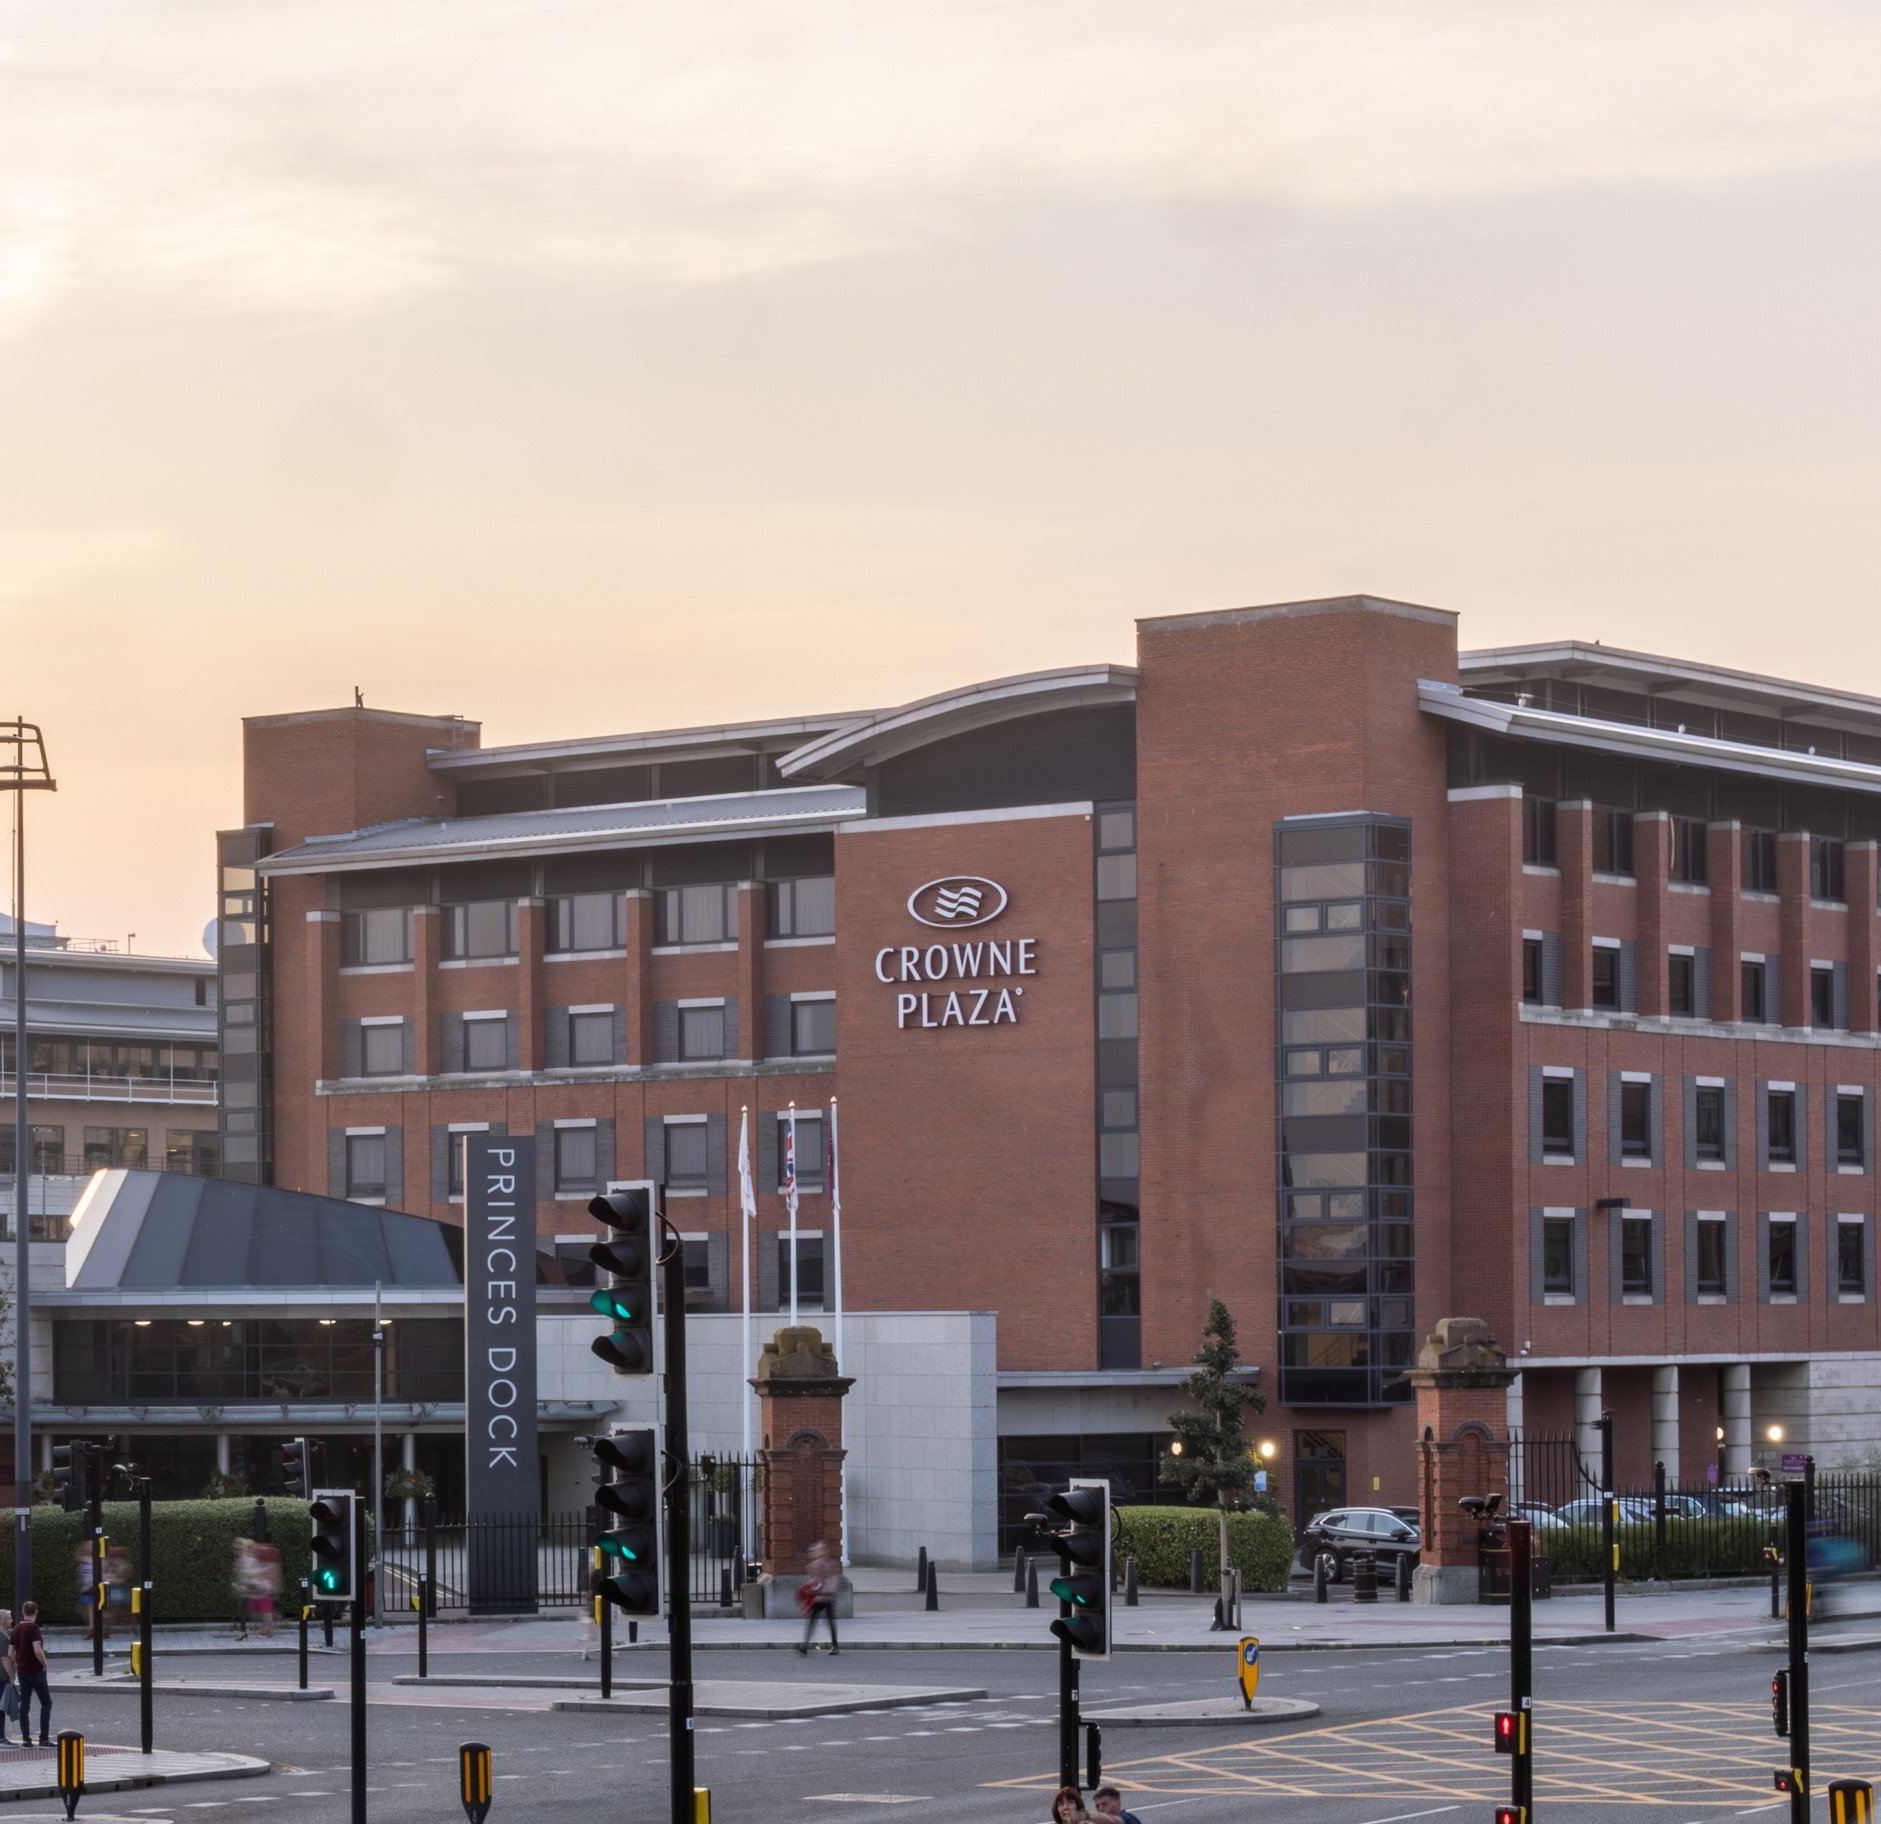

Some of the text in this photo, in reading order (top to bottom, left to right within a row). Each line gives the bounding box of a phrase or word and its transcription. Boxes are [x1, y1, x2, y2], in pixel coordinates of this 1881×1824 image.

[875, 938, 1037, 983] CROWNE
[487, 1148, 517, 1469] PRINCES DOCK
